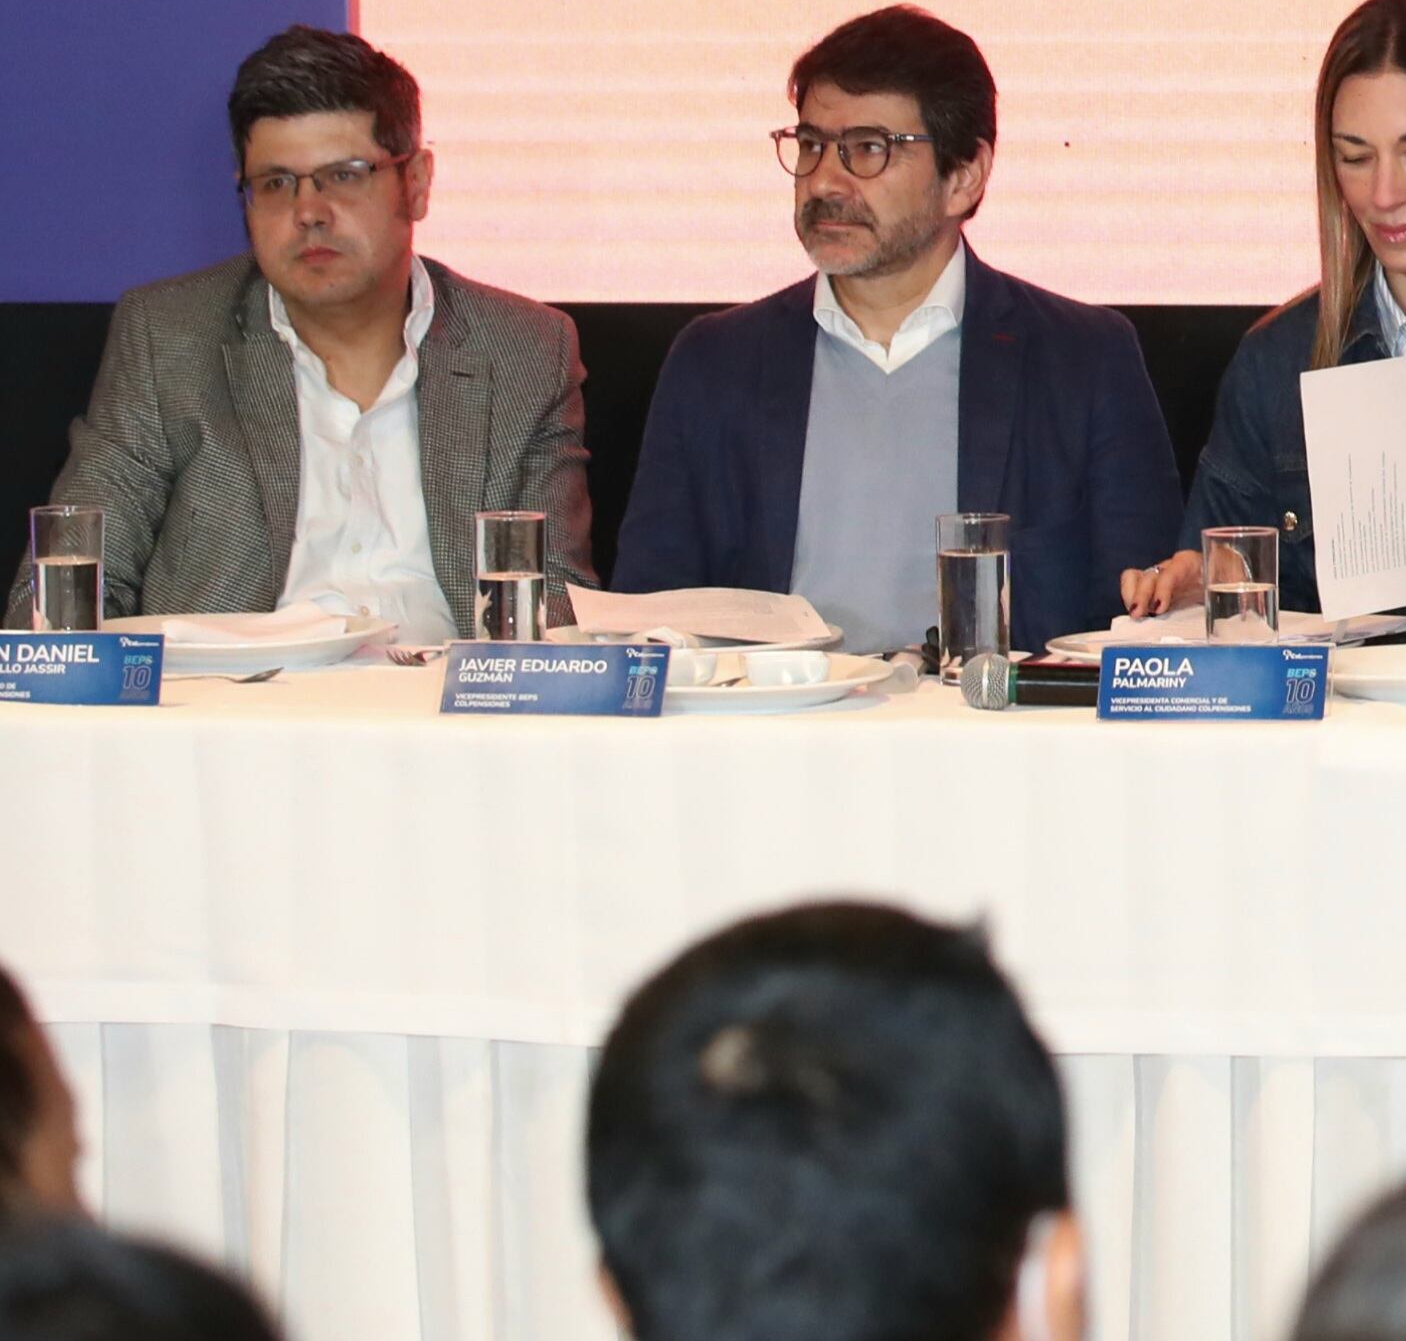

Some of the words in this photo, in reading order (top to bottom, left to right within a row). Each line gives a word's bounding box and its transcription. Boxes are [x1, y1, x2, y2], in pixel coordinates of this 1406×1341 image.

[17, 644, 100, 663] DANIEL
[24, 663, 67, 675] JASSIR
[459, 658, 517, 673] JAVIER
[521, 659, 608, 674] EDUARDO
[1114, 658, 1194, 676] PAOLA
[122, 666, 151, 690] 10
[1112, 677, 1187, 688] PALMARINY
[626, 675, 656, 700] 10
[1285, 679, 1315, 704] 10
[455, 693, 517, 701] VICEPRESIDENTE
[1110, 705, 1142, 713] SERVICIO
[1143, 705, 1153, 713] AL
[1154, 705, 1197, 713] CIUDADANO
[1198, 705, 1251, 713] COLPENSIONES
